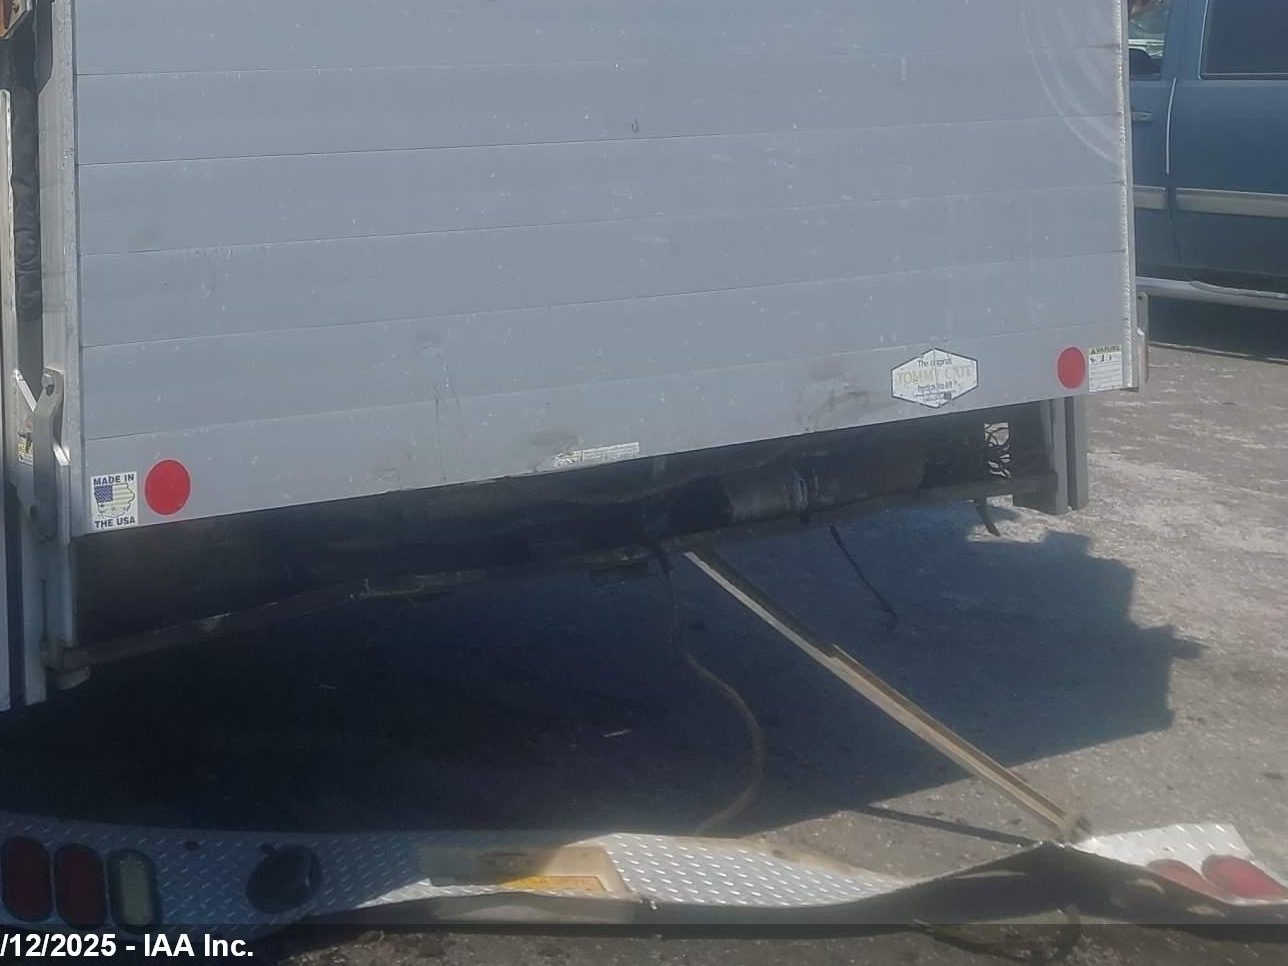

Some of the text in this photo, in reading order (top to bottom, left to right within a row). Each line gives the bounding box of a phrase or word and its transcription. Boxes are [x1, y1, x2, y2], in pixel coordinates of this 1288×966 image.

[93, 475, 120, 485] MADE
[94, 516, 136, 528] THE USA
